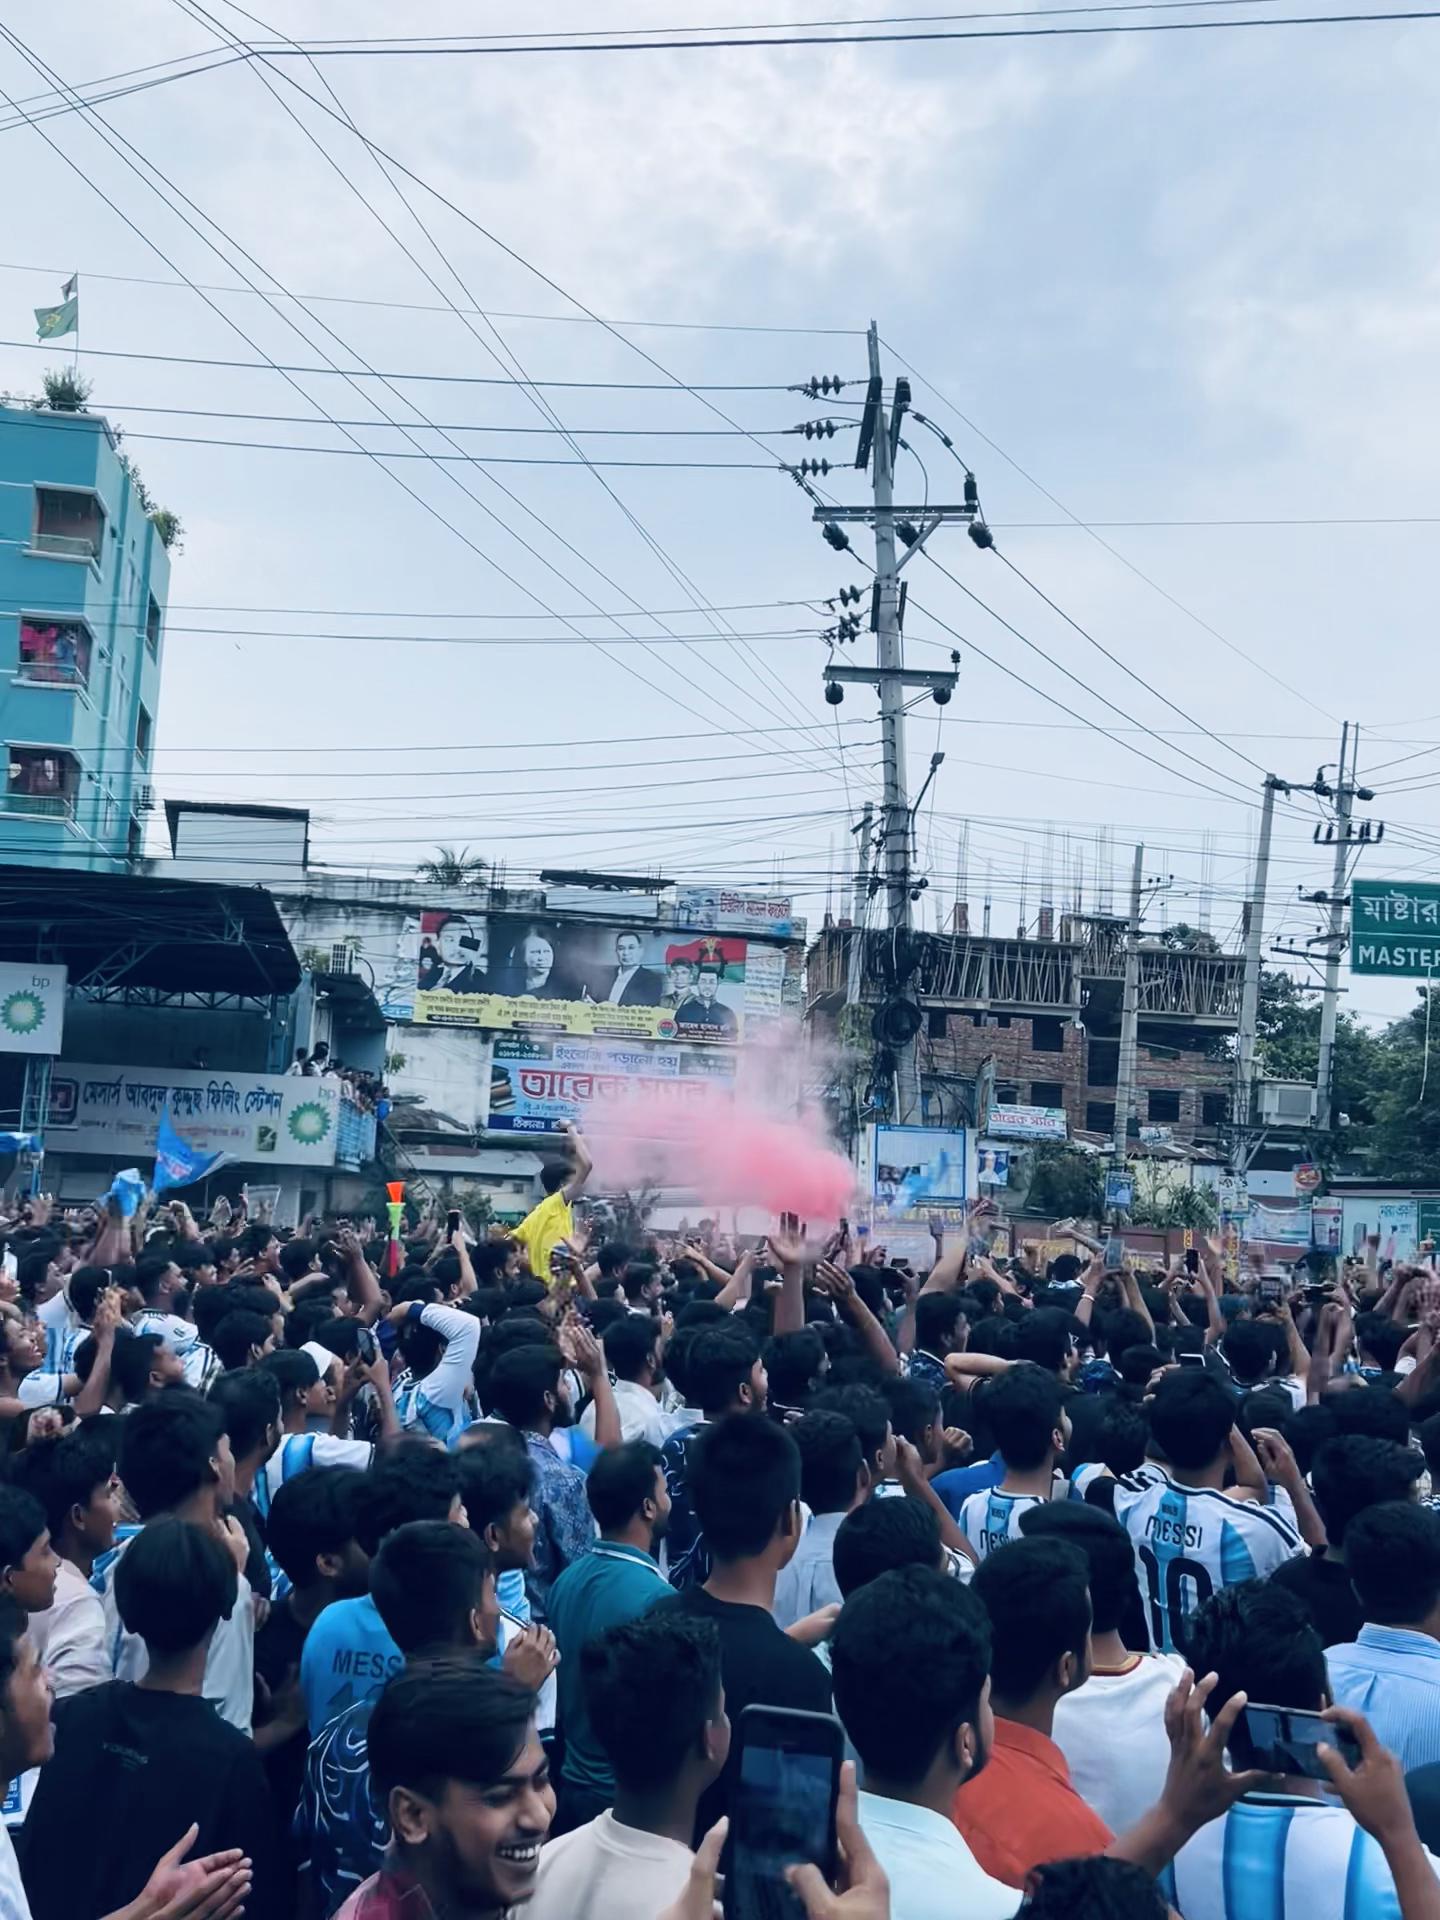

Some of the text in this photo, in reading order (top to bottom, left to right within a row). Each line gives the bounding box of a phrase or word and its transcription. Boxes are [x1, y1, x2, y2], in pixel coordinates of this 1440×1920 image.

[32, 974, 51, 990] bp
[83, 1074, 124, 1106] মেসার্স
[125, 1082, 168, 1115] আবদুল
[206, 1079, 241, 1116] ফিলিং
[318, 1085, 336, 1100] bp
[519, 1068, 631, 1103] তারেক
[1145, 1514, 1203, 1549] MESSI
[1139, 1544, 1214, 1652] 10
[332, 1648, 403, 1680] MESS
